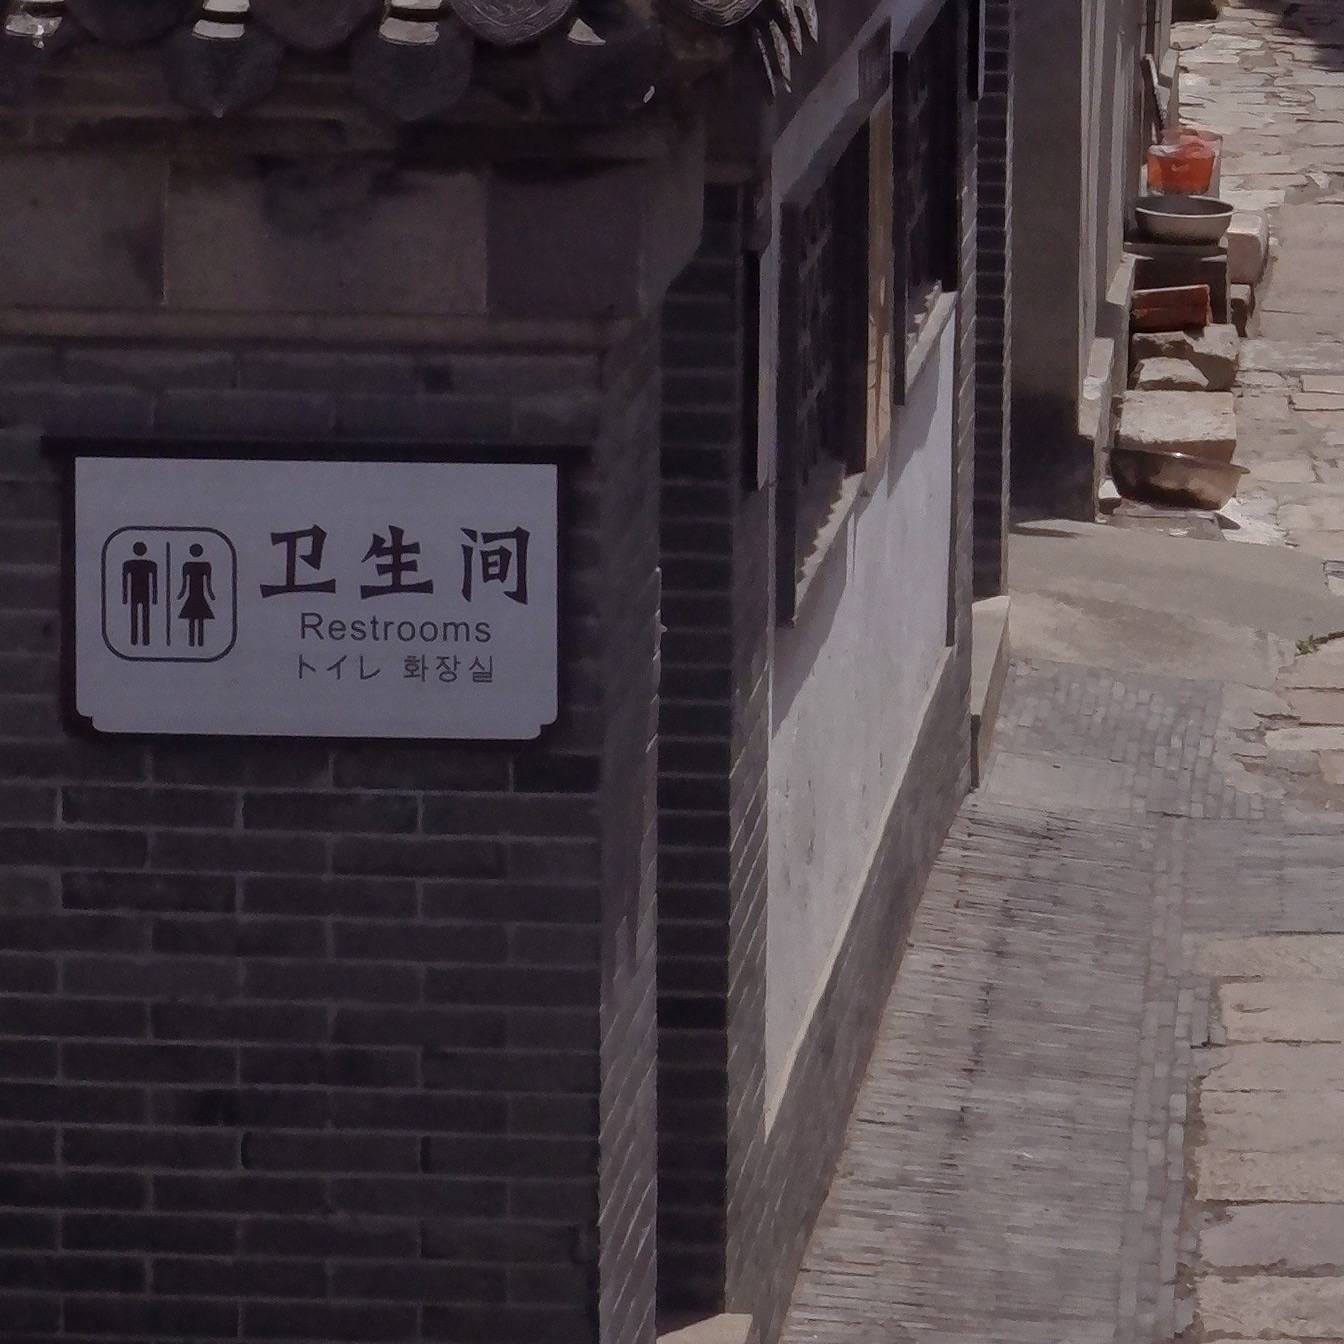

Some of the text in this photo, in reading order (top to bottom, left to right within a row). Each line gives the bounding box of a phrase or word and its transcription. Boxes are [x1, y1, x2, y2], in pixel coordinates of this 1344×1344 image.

[259, 524, 530, 605] 卫生间
[300, 612, 491, 643] Restrooms
[298, 654, 494, 684] トイレ 화장실
